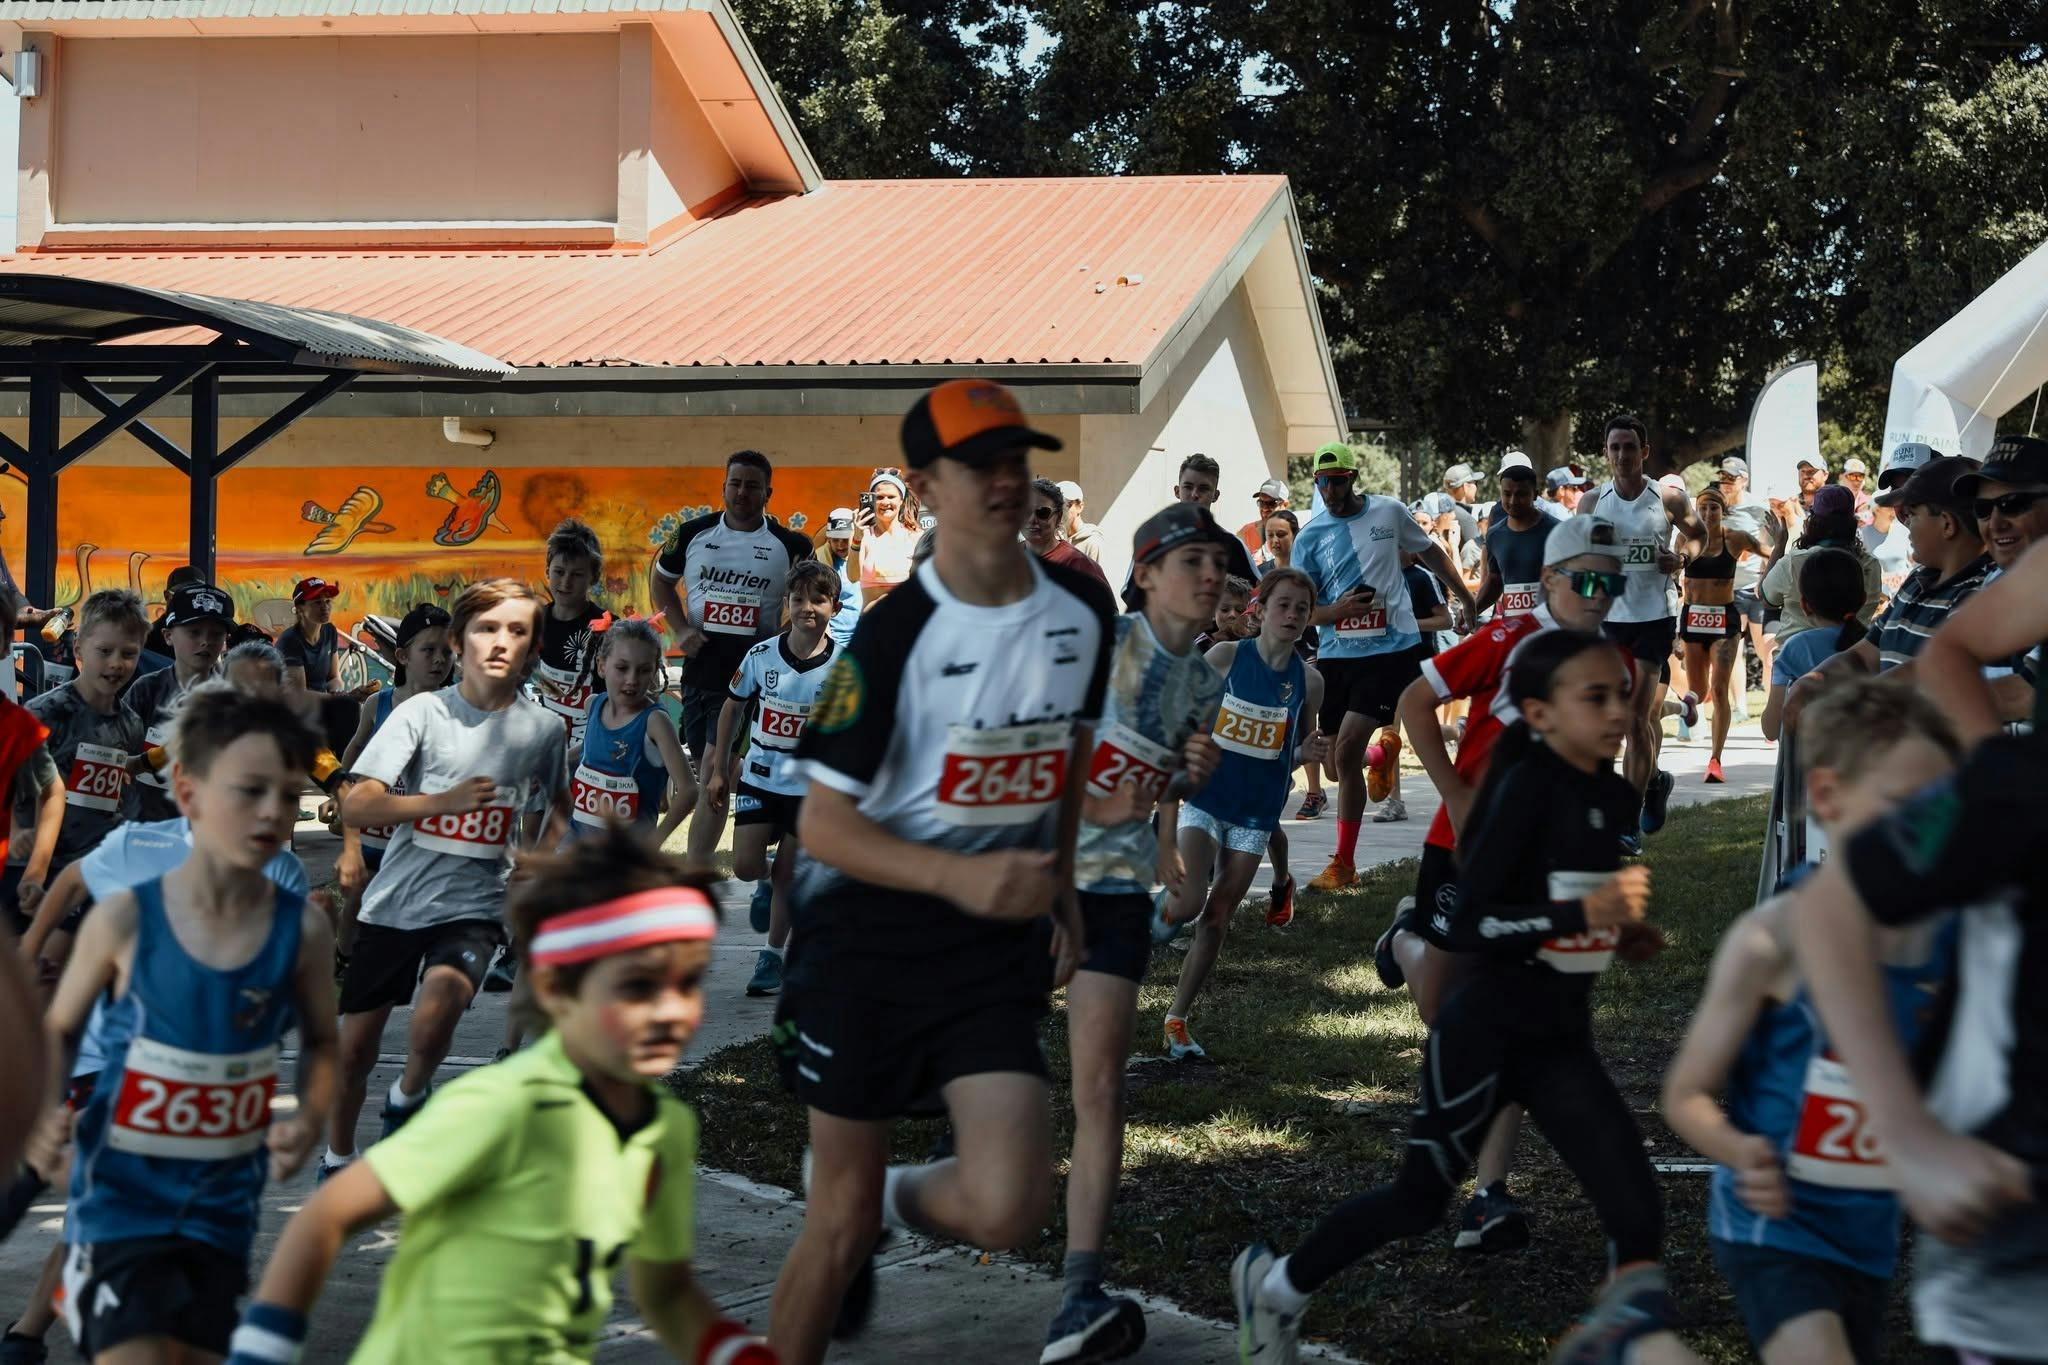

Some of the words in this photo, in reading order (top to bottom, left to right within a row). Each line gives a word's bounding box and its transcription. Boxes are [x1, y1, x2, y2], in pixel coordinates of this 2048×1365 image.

[1889, 432, 1910, 443] RUN
[699, 565, 771, 590] Nutrien
[707, 604, 754, 626] 2684
[1341, 611, 1381, 629] 2647
[1691, 613, 1722, 627] 2699
[1221, 713, 1277, 747] 2513
[76, 764, 123, 796] 269
[951, 754, 1058, 803] 2645
[574, 783, 632, 817] 2606
[421, 810, 504, 841] 2688
[129, 1079, 266, 1135] 2630
